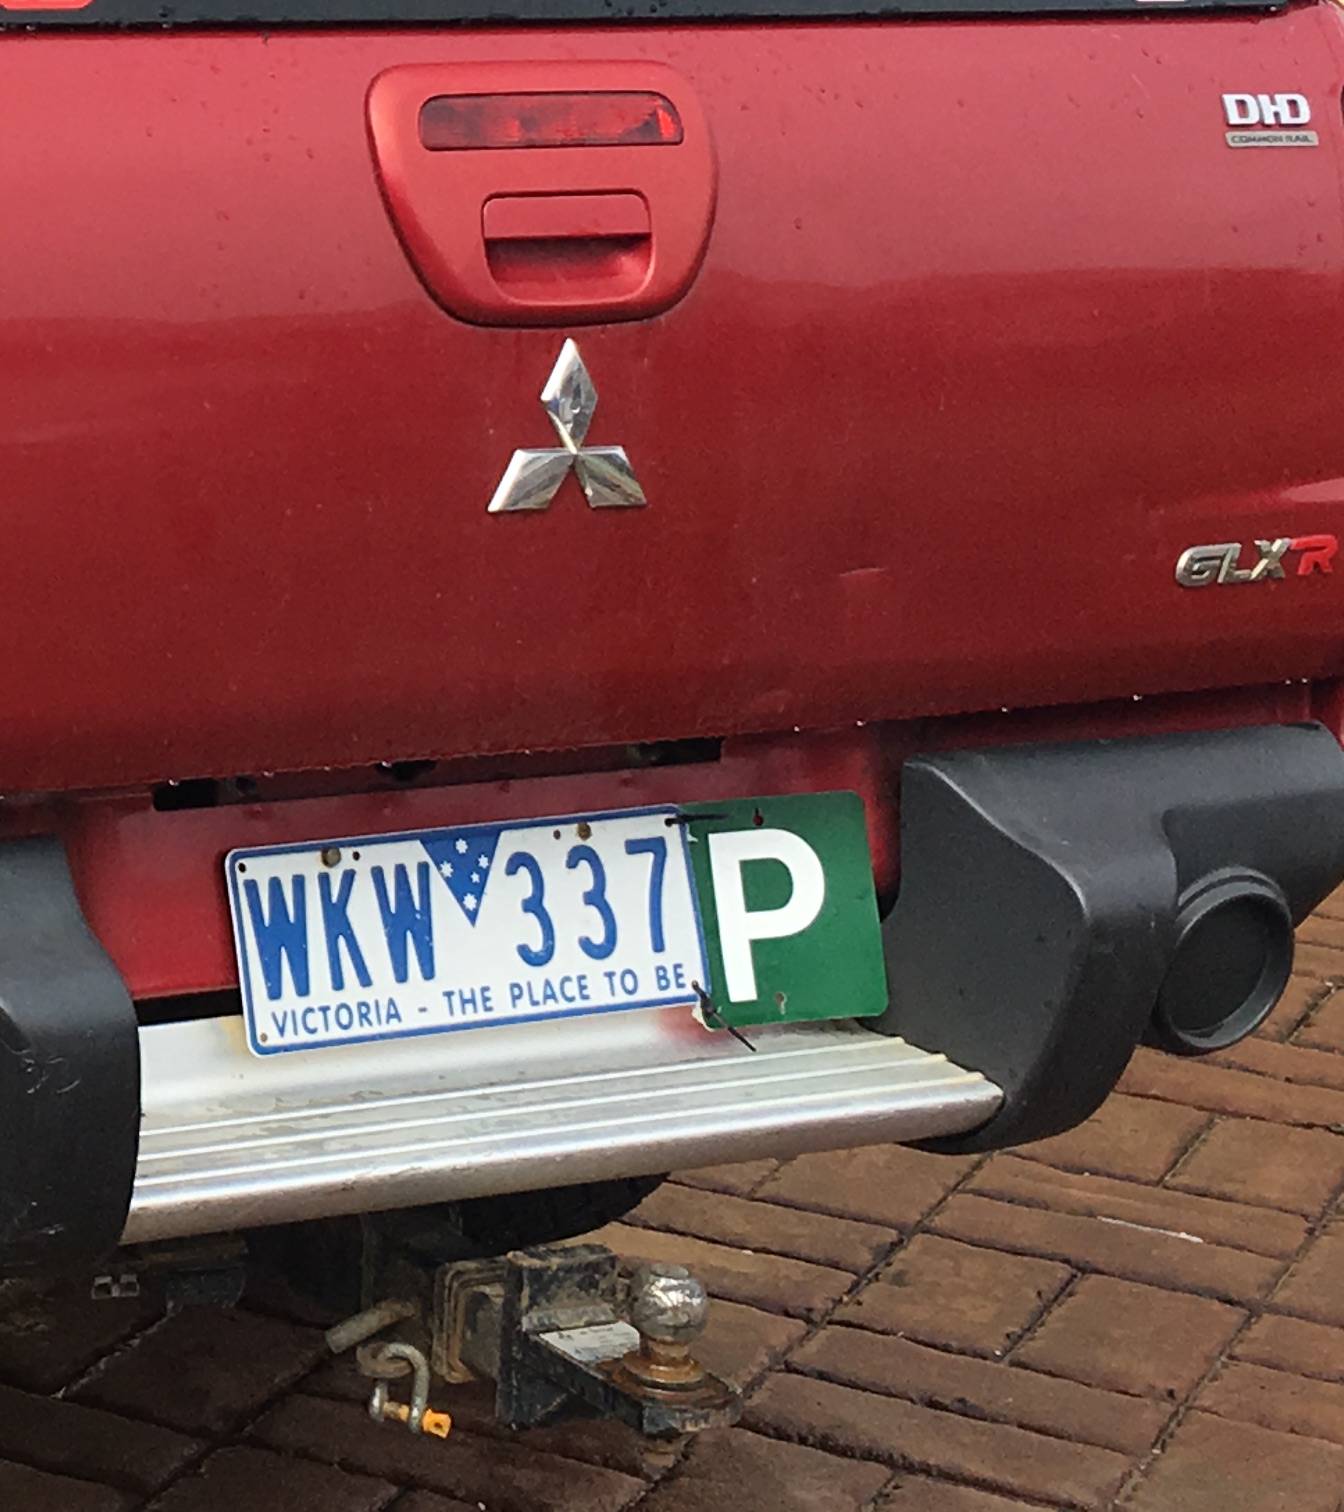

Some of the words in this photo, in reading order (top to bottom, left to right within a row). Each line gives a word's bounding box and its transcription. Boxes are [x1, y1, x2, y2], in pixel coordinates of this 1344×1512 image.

[242, 861, 436, 1002] WKW
[505, 836, 668, 968] 337
[708, 828, 826, 1003] P
[270, 996, 403, 1039] VICTORIA
[442, 985, 495, 1017] THE
[509, 973, 591, 1009] PLACE
[604, 967, 639, 997] TO
[655, 962, 687, 991] BE
